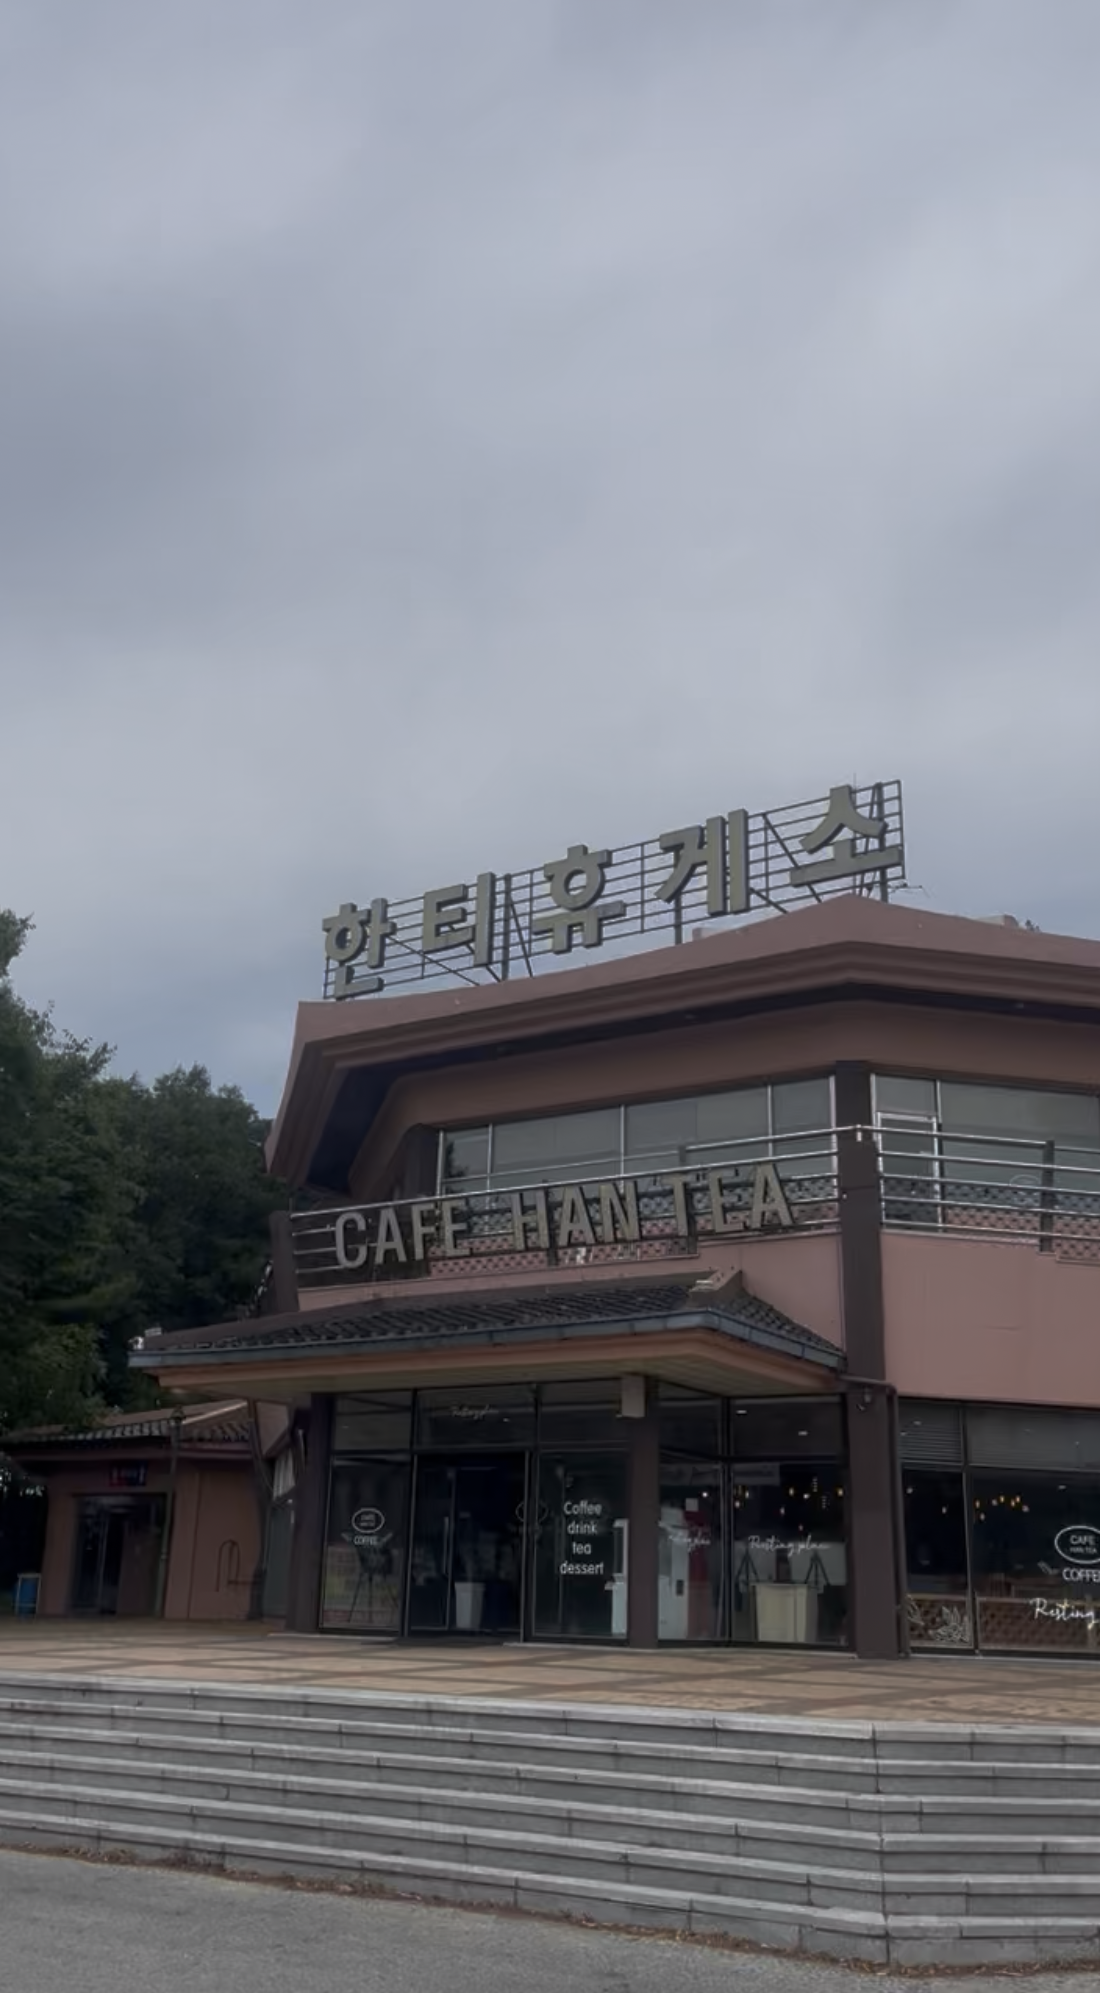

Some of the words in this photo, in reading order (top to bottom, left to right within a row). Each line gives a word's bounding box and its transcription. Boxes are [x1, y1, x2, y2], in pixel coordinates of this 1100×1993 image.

[335, 1200, 472, 1269] CAFE
[511, 1180, 643, 1251] HAN
[663, 1163, 797, 1237] TEA
[563, 1500, 602, 1515] Coffee
[567, 1520, 597, 1535] drink
[1069, 1534, 1096, 1546] CAFE
[572, 1541, 591, 1555] tea
[559, 1560, 604, 1575] dessert
[1029, 1597, 1096, 1630] Resting
